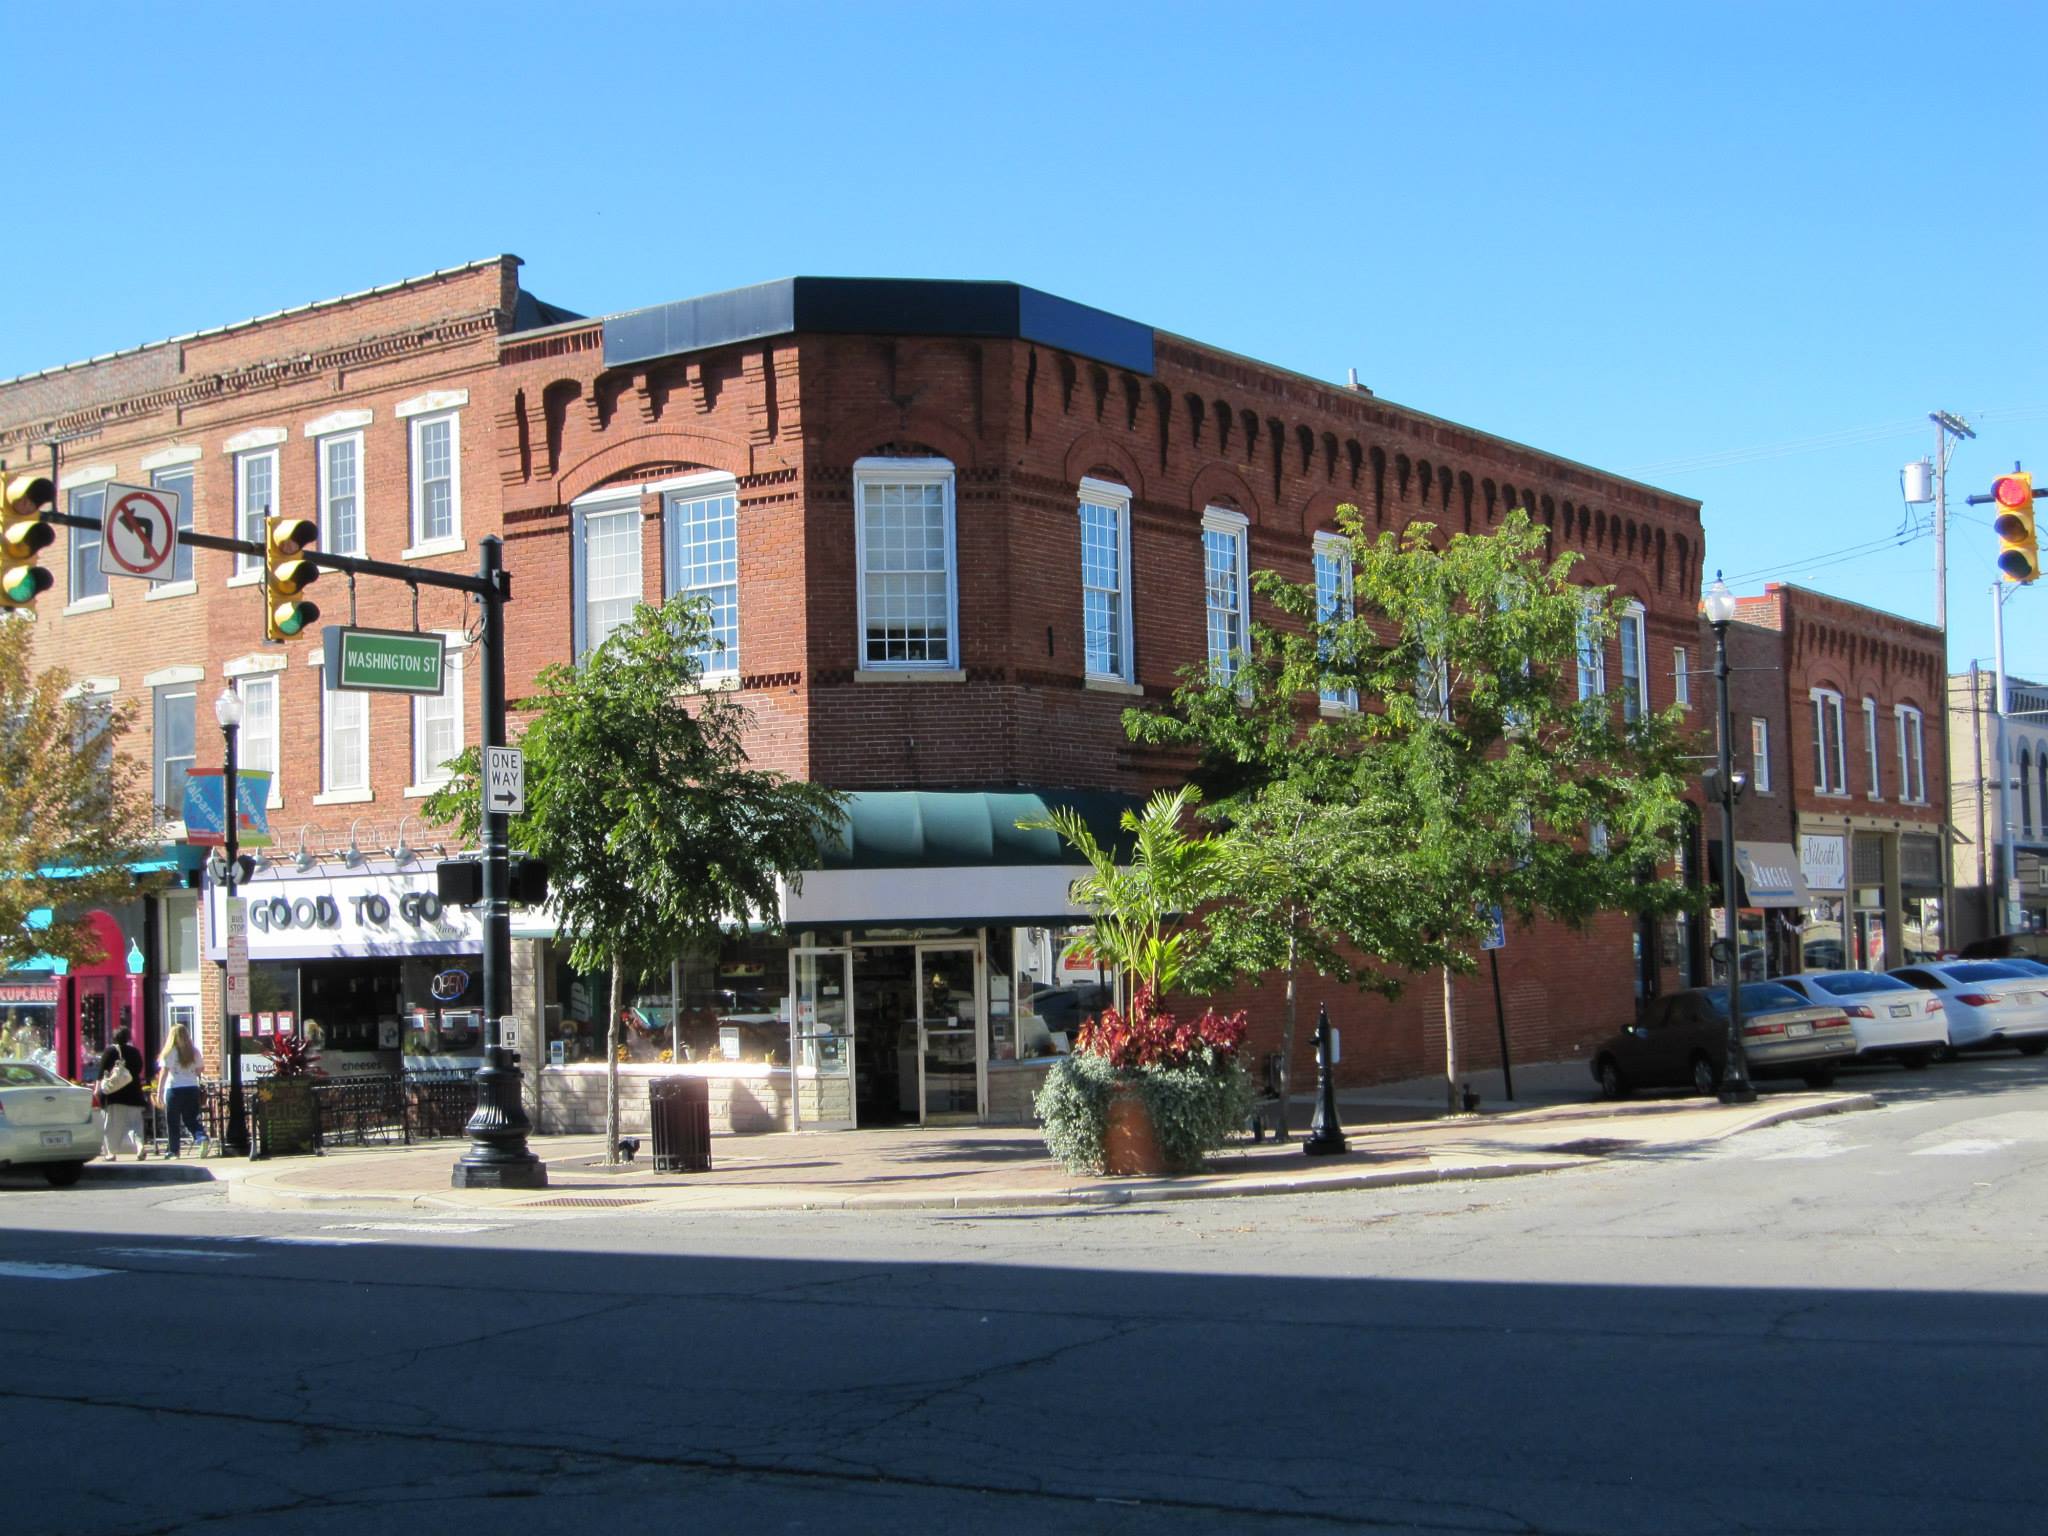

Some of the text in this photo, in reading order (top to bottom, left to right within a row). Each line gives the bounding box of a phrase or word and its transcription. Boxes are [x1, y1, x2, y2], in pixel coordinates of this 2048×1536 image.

[348, 650, 437, 673] WASHINGTON ST
[492, 753, 518, 769] ONE
[492, 771, 519, 787] WAY
[231, 915, 244, 923] BUS
[250, 891, 443, 932] GOOD TO GO
[230, 924, 245, 933] STOP
[433, 974, 464, 995] OPEN
[342, 1061, 383, 1071] cheeses
